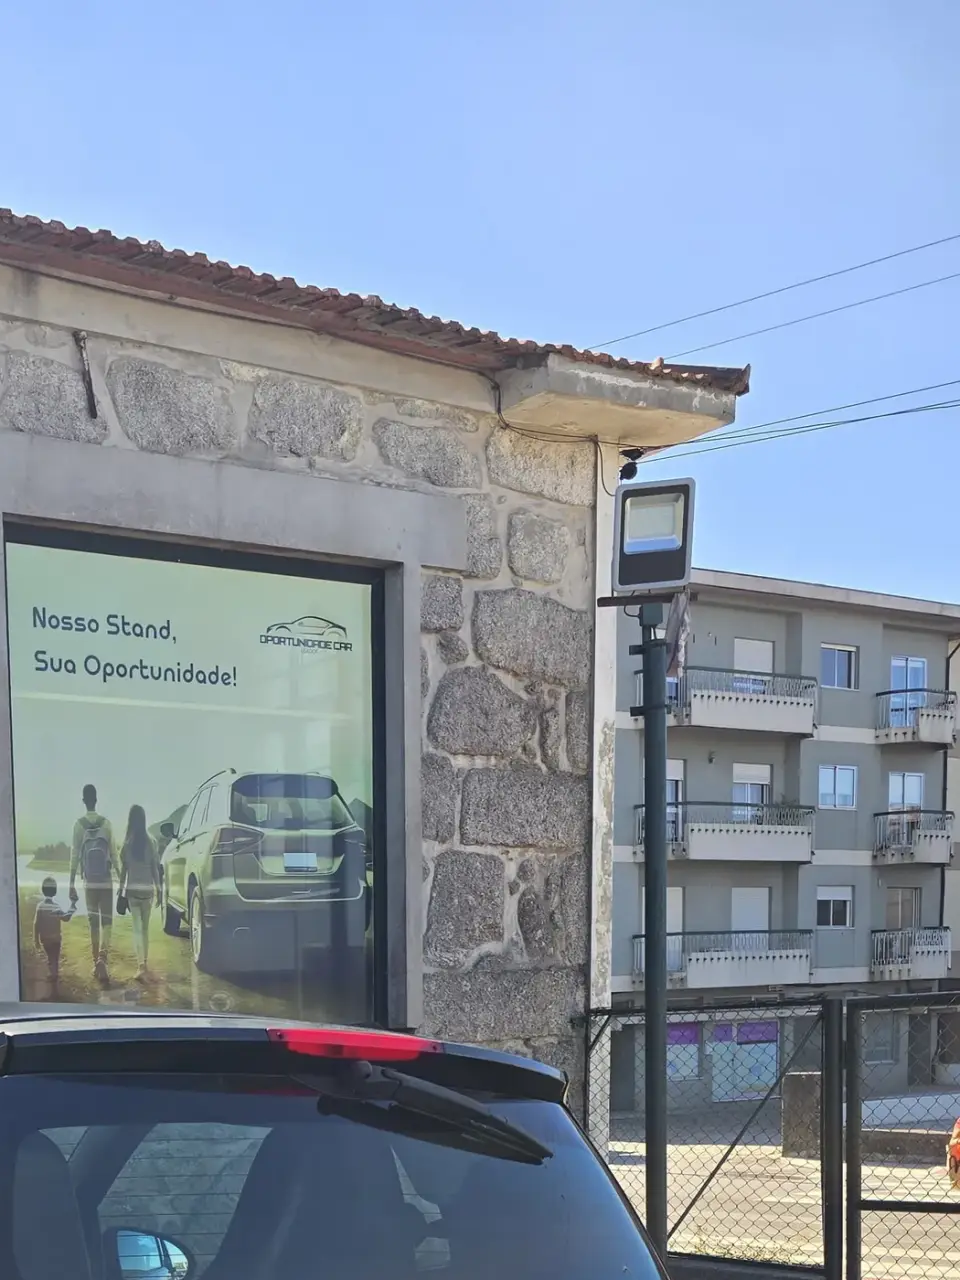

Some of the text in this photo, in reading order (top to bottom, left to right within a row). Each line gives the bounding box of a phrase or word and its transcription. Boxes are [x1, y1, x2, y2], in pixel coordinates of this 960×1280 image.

[32, 606, 177, 644] Nosso Stand,
[259, 634, 332, 650] OPORTUNIDADE
[333, 641, 353, 652] CAR
[34, 650, 237, 687] Sua Oportunidade!
